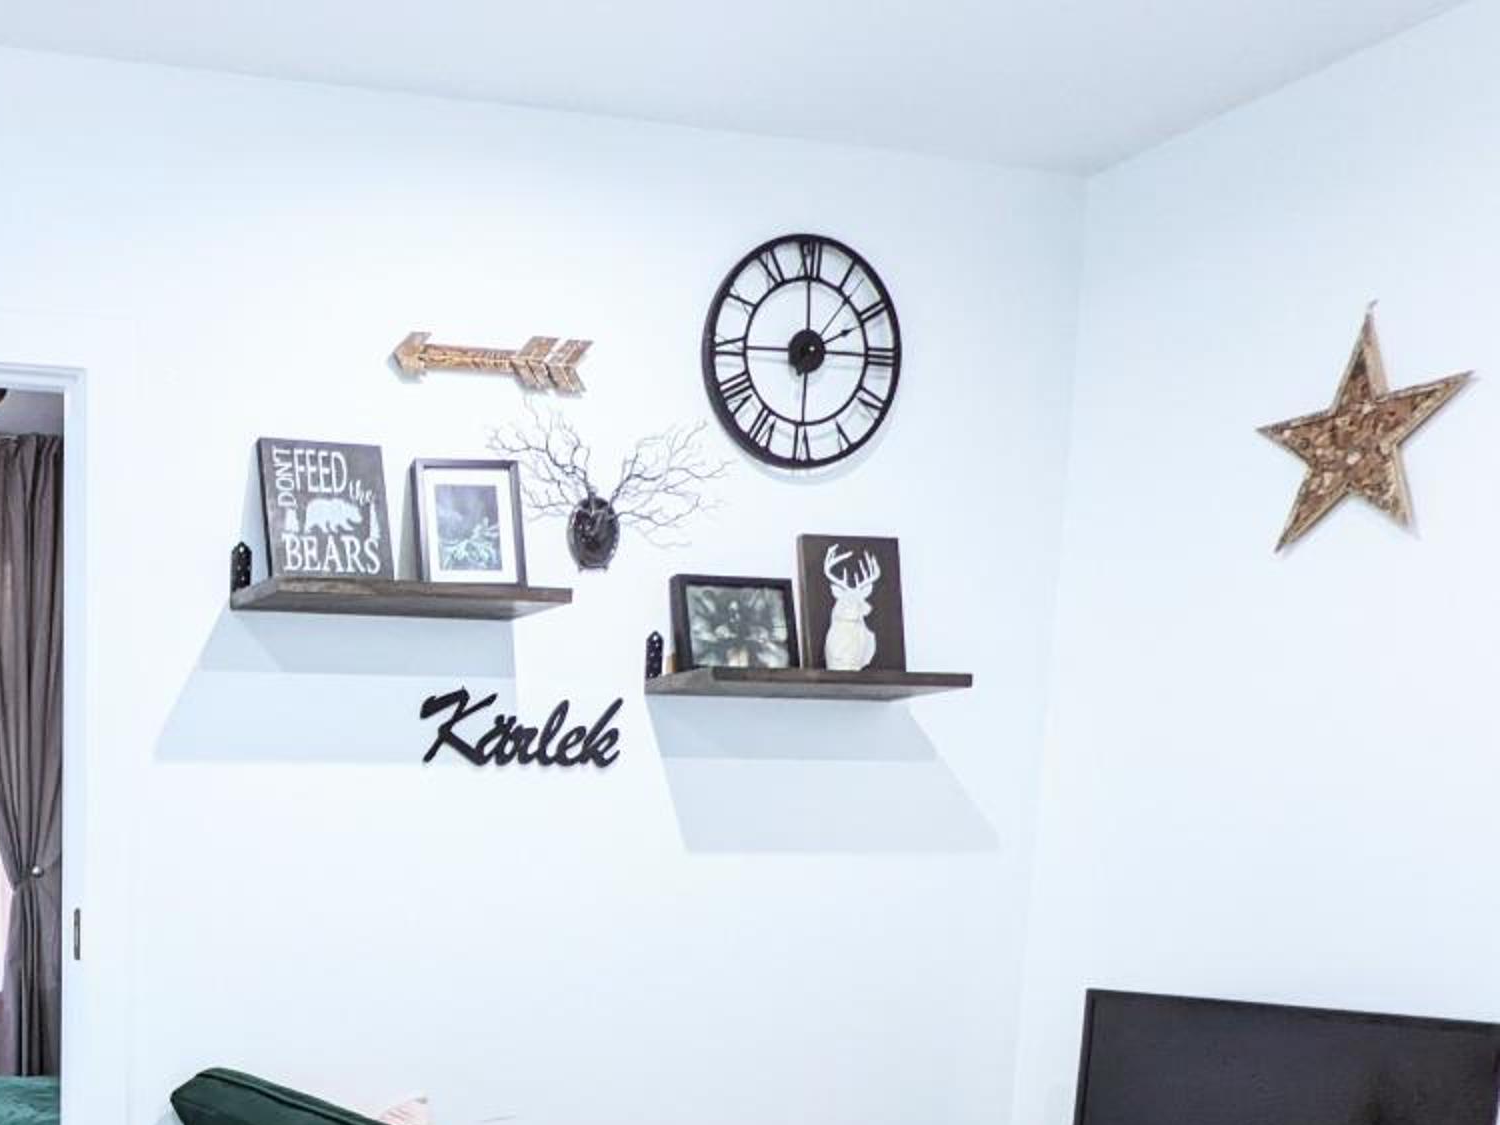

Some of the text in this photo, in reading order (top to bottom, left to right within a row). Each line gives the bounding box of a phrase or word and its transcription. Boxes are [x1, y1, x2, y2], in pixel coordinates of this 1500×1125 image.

[293, 447, 347, 493] FEED
[349, 479, 374, 507] the
[280, 532, 382, 575] BEARS
[420, 687, 623, 768] Kärlek
